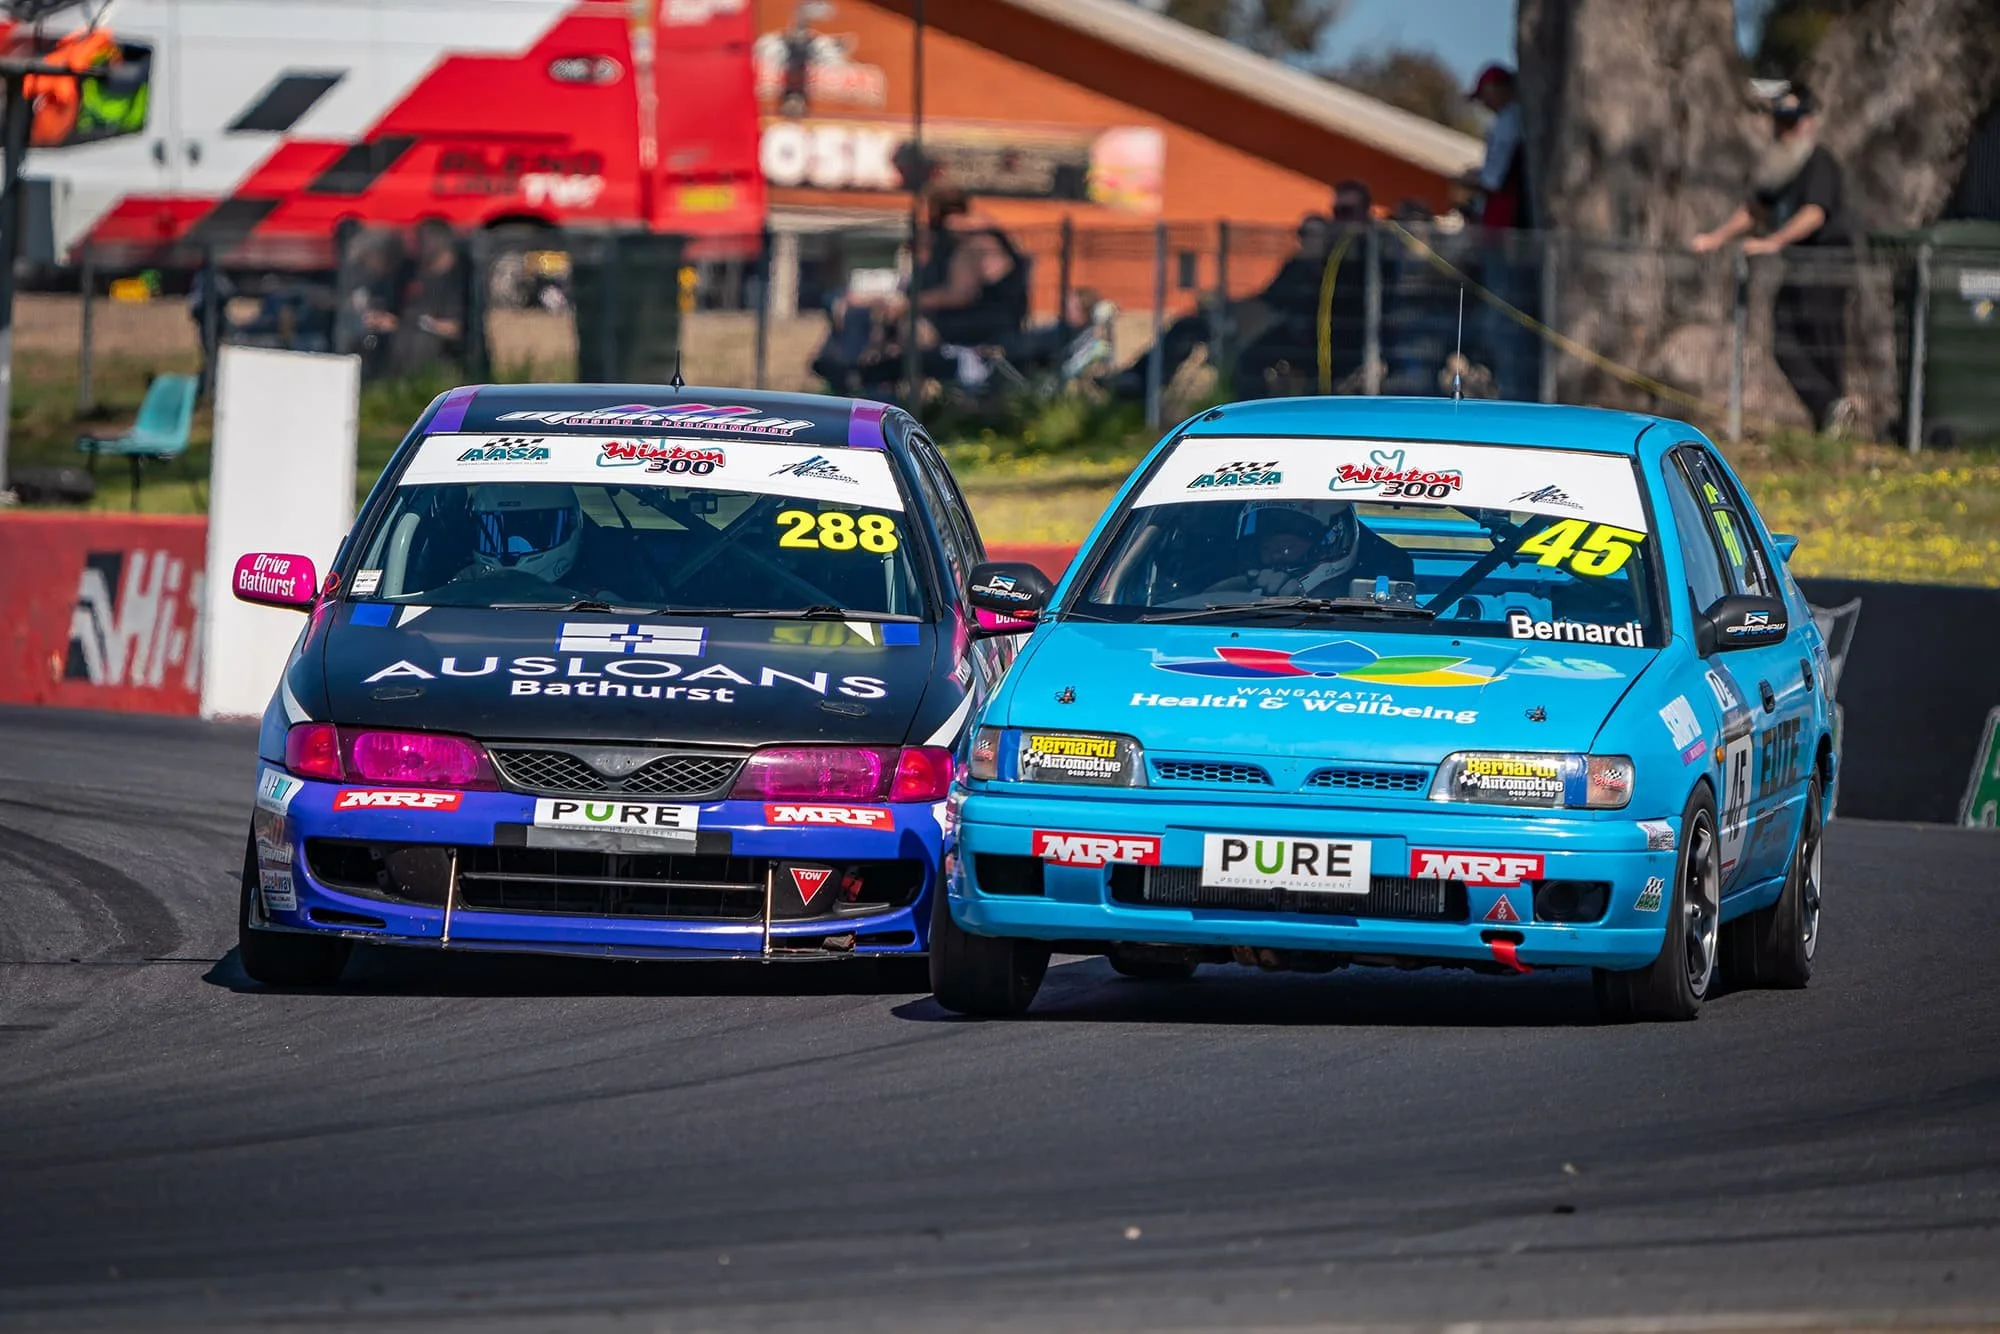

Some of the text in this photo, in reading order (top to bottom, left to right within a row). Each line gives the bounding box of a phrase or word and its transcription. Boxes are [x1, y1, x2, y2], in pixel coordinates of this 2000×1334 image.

[457, 446, 550, 462] AASA
[602, 440, 726, 466] Winton
[645, 456, 717, 476] 300
[1337, 462, 1463, 491] Winton
[1186, 470, 1283, 489] AASA
[1379, 481, 1451, 500] 300
[776, 509, 899, 554] 288
[1516, 517, 1648, 577] 45
[253, 553, 291, 575] Drive
[239, 569, 296, 597] Bathurst
[1509, 614, 1645, 648] Bernardi
[361, 655, 889, 699] AUSLOANS
[509, 678, 735, 704] Bathurst
[1236, 686, 1395, 703] WANGARATTA
[1129, 692, 1480, 725] Health & Wellbeing
[1031, 735, 1118, 759] Bernardi
[1041, 753, 1122, 773] Automotive
[1480, 775, 1564, 792] Automotive
[339, 791, 457, 808] MRF
[551, 801, 681, 827] PURE
[772, 805, 887, 826] MRF
[1039, 834, 1155, 865] MRF
[1220, 838, 1353, 877] PURE
[799, 871, 822, 881] TOW
[1417, 853, 1539, 884] MRF
[1220, 877, 1353, 889] PROPERTY MANAGEMENT
